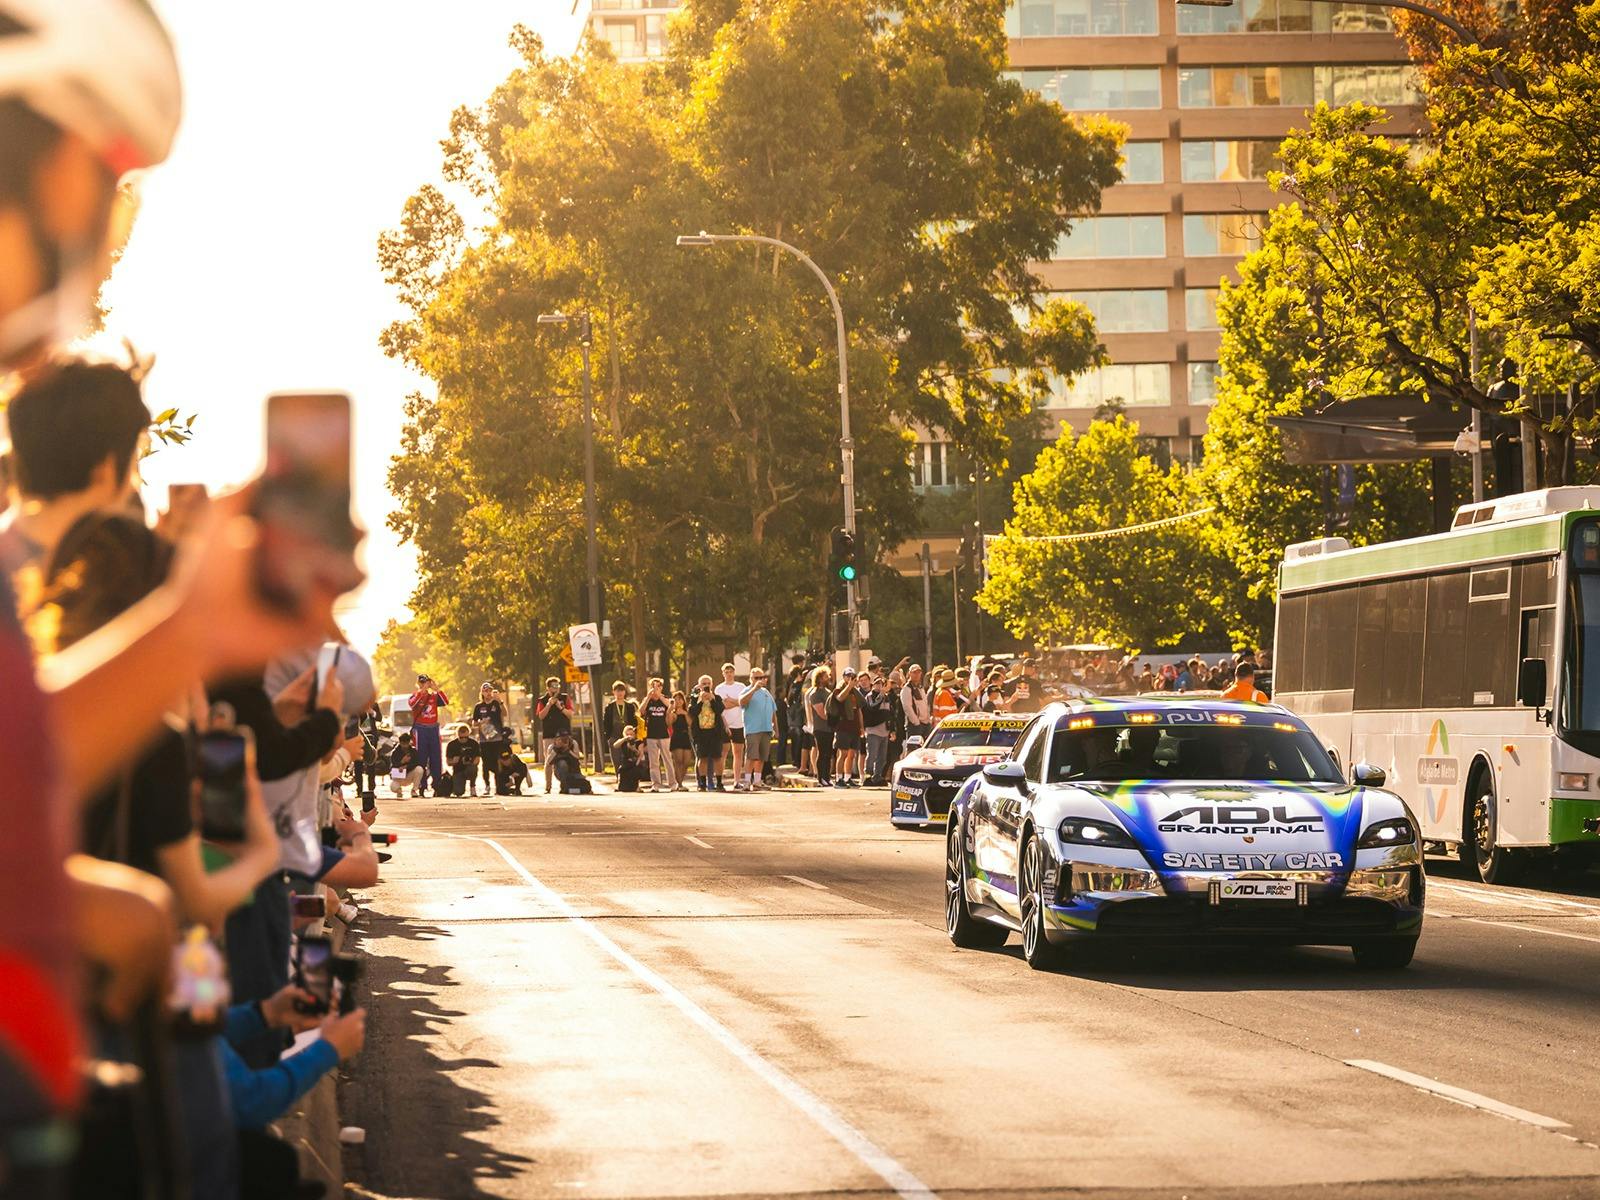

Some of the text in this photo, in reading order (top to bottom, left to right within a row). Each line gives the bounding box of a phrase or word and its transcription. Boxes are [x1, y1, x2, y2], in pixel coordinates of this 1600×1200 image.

[1166, 711, 1247, 724] pulse
[941, 720, 1024, 728] NATIONAL STOR
[1158, 806, 1323, 825] ADL
[1157, 824, 1325, 834] GRAND FINAL
[1162, 851, 1344, 870] SAFETY CAR
[1232, 885, 1265, 895] ADL
